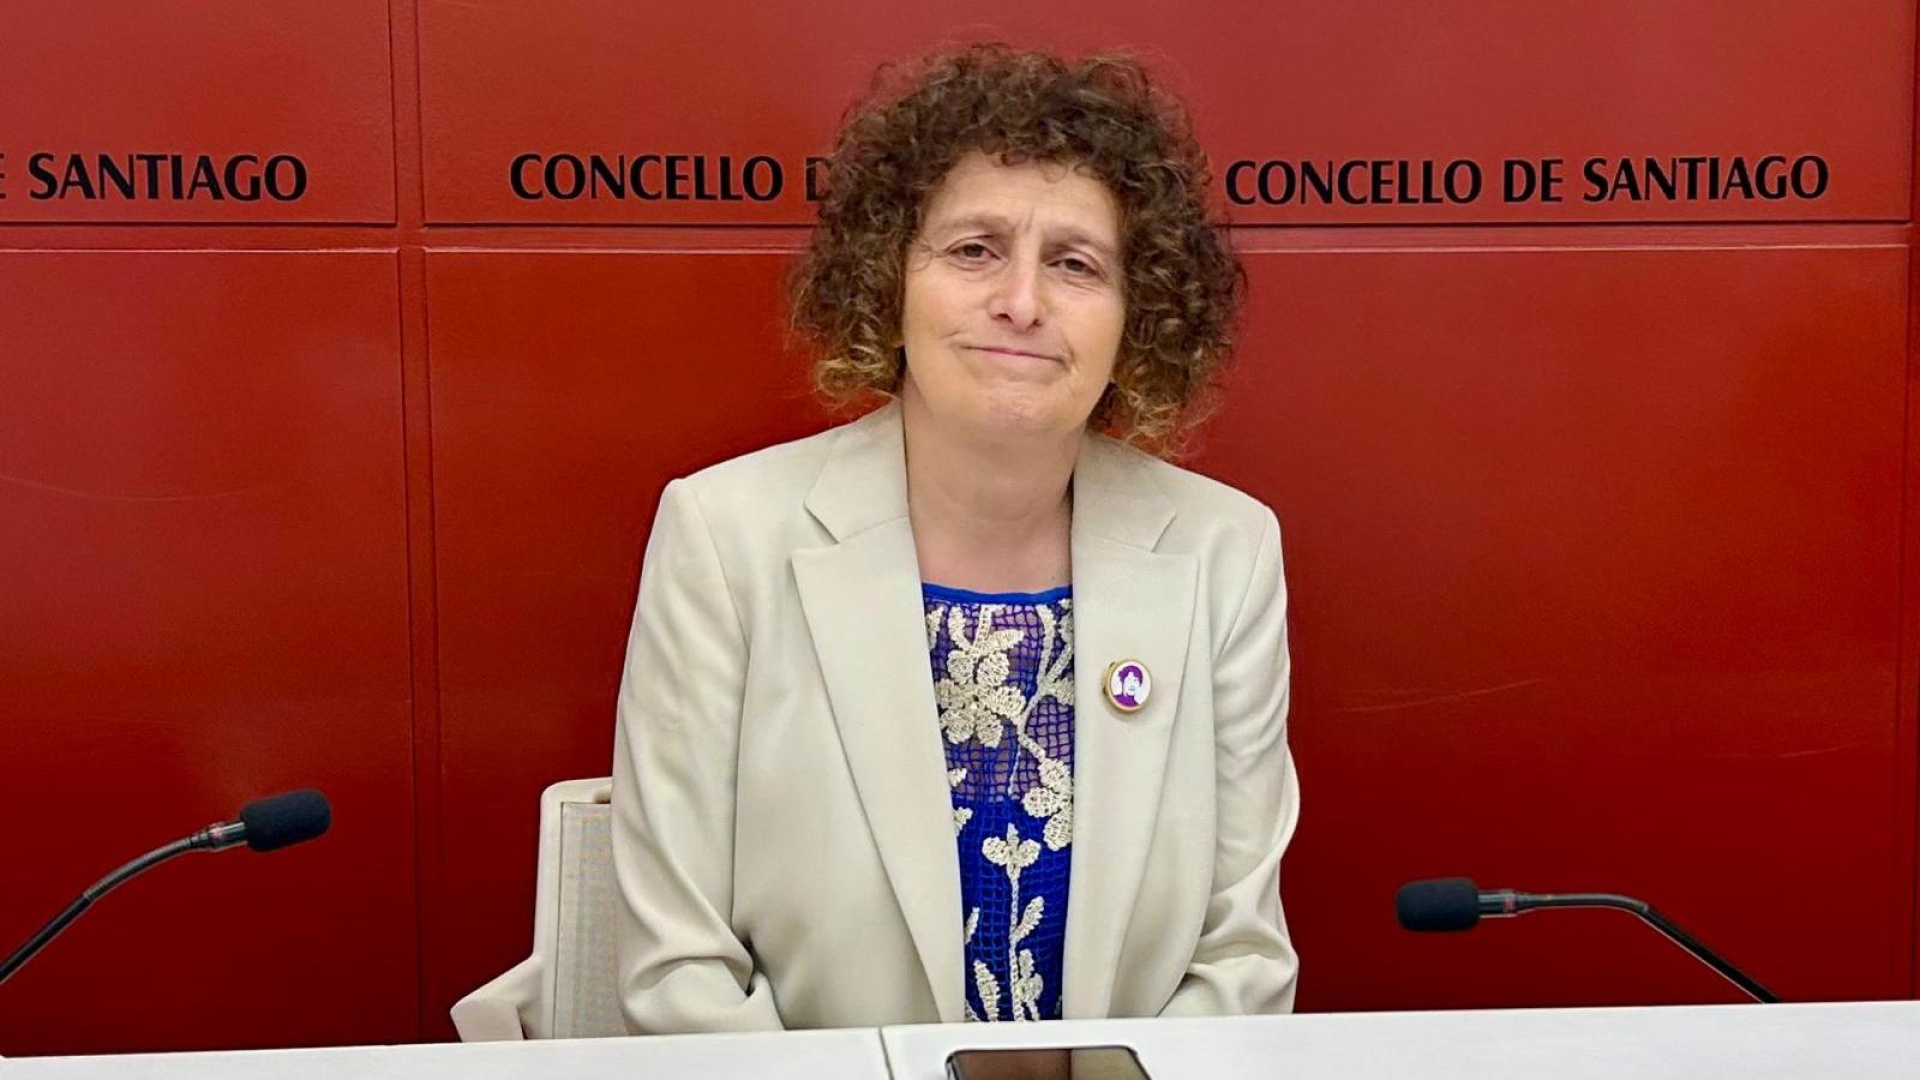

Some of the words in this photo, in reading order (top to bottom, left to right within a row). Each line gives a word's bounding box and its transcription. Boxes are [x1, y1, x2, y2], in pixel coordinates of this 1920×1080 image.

[28, 153, 307, 201] SANTIAGO
[510, 154, 783, 201] CONCELLO
[1226, 160, 1482, 205] CONCELLO
[1503, 159, 1562, 203] DE
[1583, 155, 1829, 202] SANTIAGO
